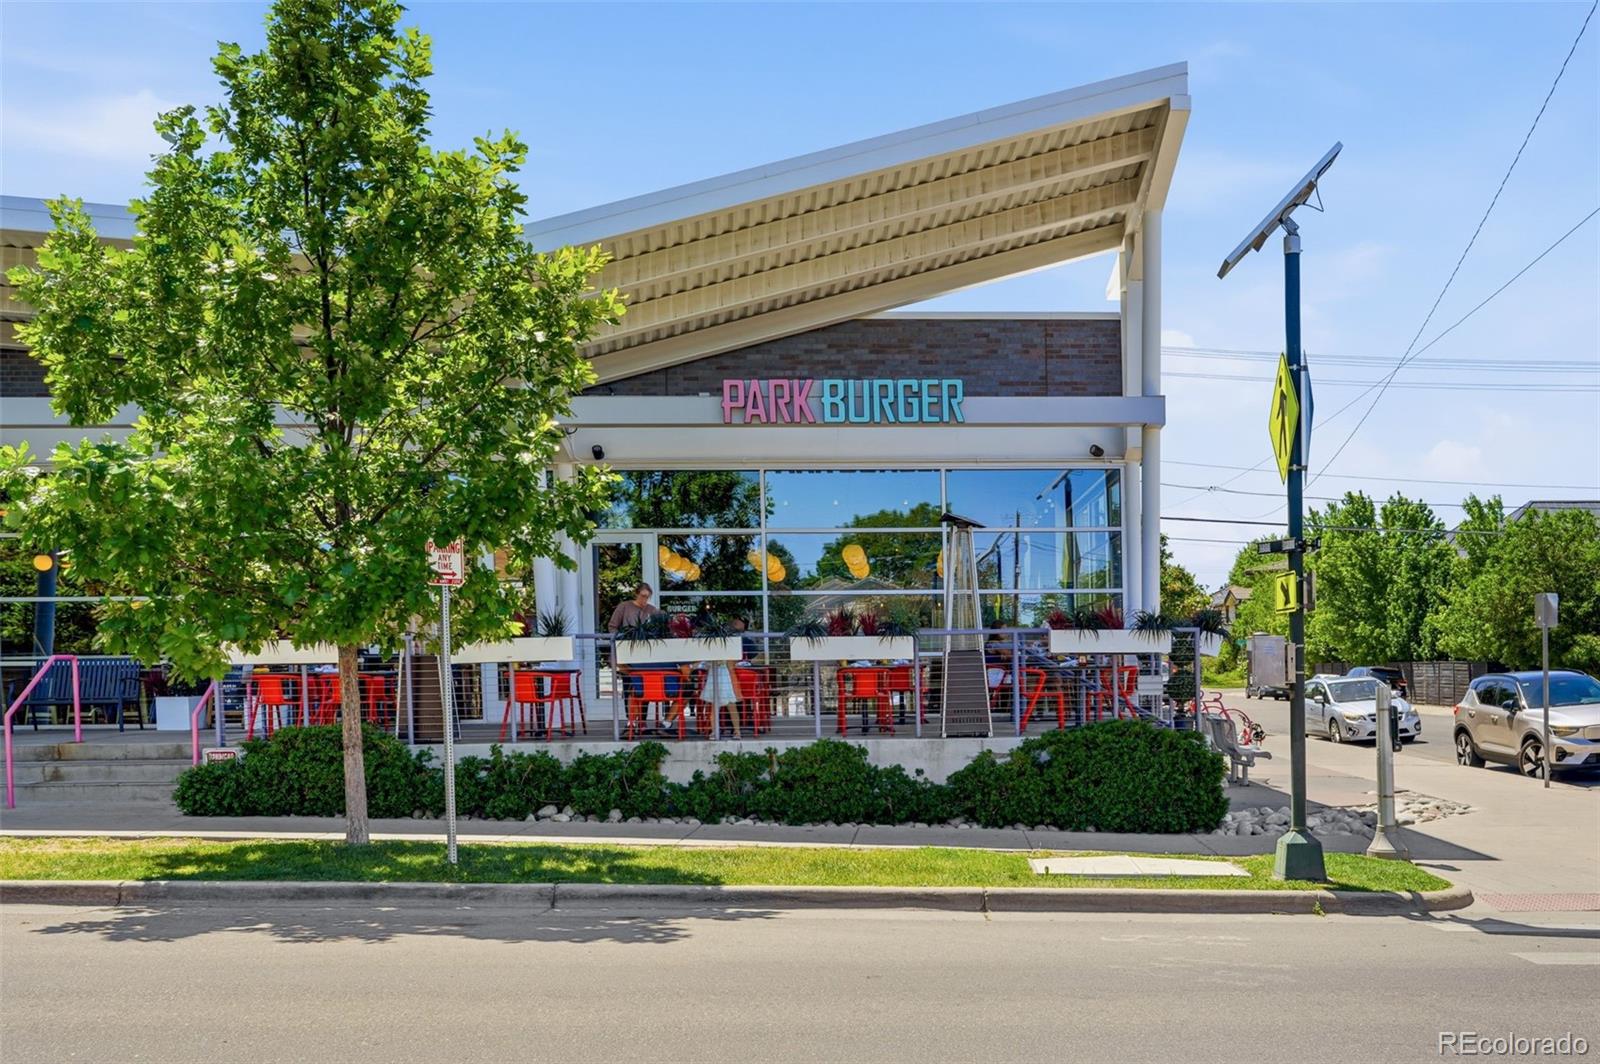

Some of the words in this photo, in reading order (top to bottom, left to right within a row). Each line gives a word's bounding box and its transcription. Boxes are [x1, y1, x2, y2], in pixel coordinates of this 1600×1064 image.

[721, 378, 816, 424] PARK
[821, 378, 965, 424] BURGER
[428, 541, 460, 554] PING
[437, 562, 453, 570] TIME
